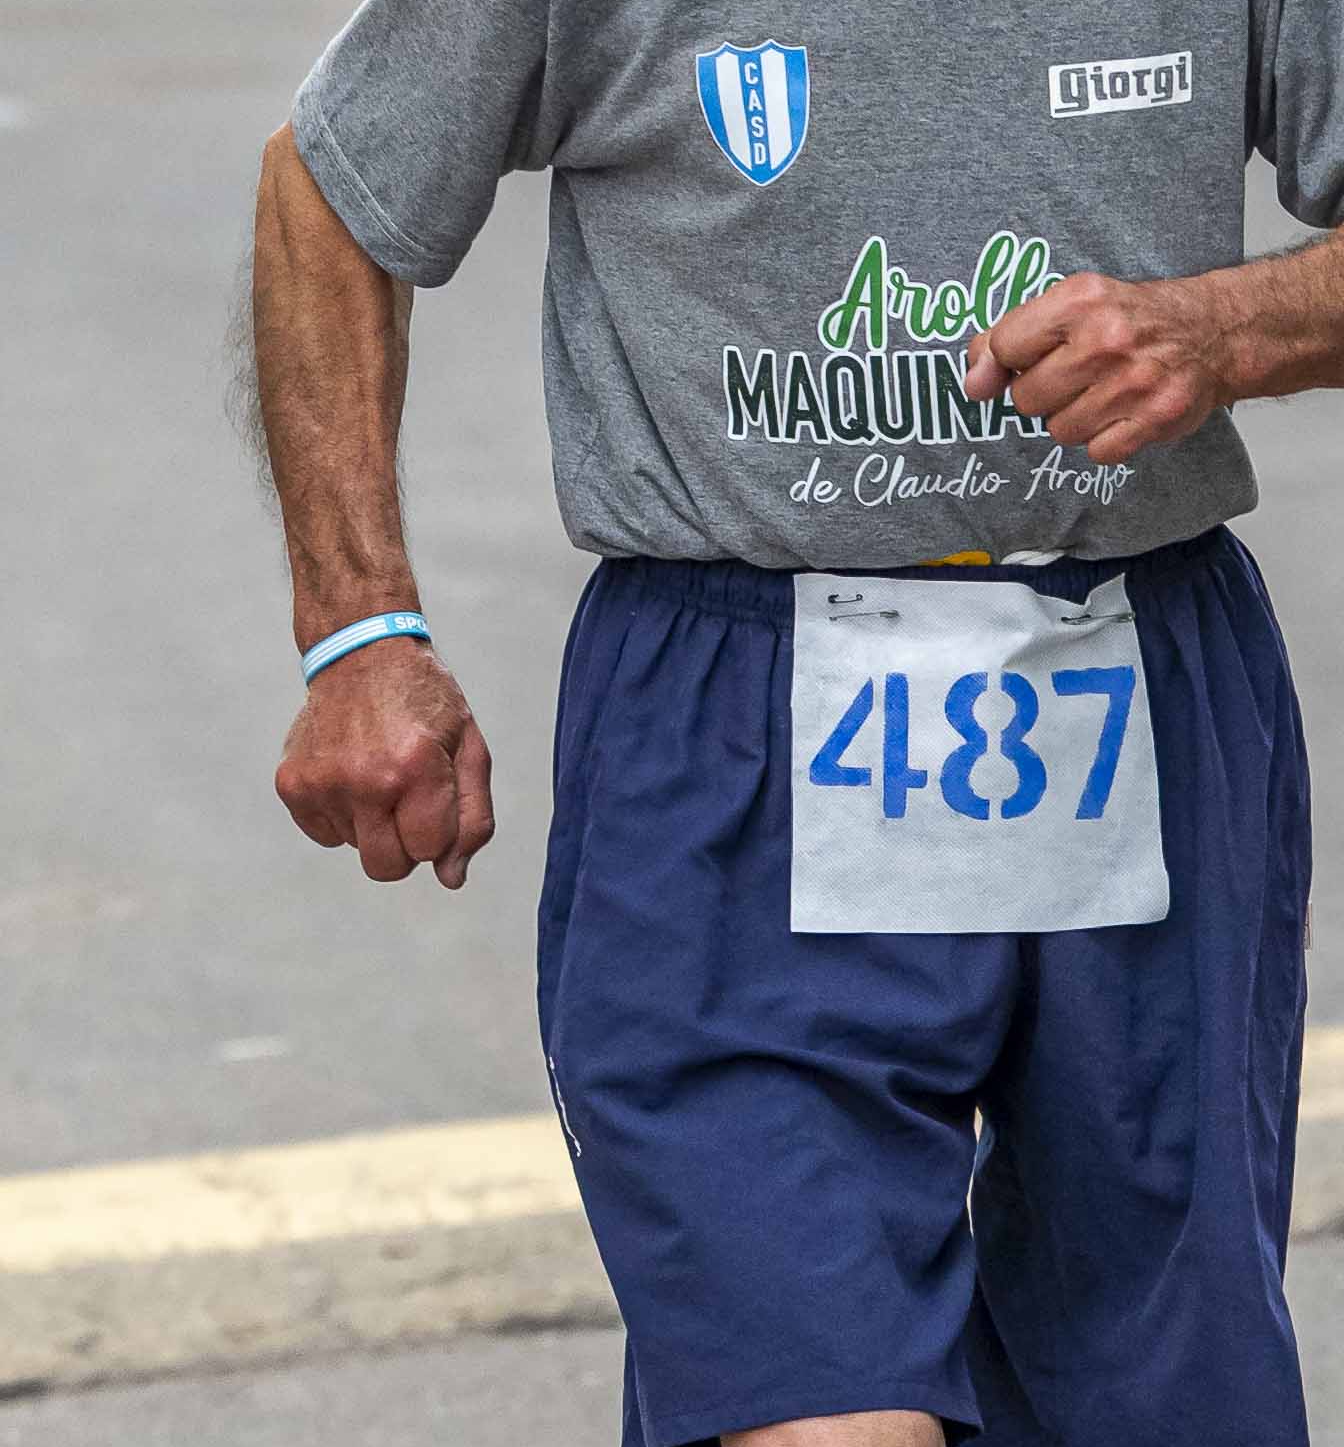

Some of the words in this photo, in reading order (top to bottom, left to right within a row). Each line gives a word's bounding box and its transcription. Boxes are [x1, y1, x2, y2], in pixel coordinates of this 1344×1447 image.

[743, 61, 768, 165] CASD
[722, 345, 1051, 446] MAQUINA
[789, 456, 843, 507] de
[853, 453, 1009, 508] Claudio
[809, 664, 1137, 821] 487
